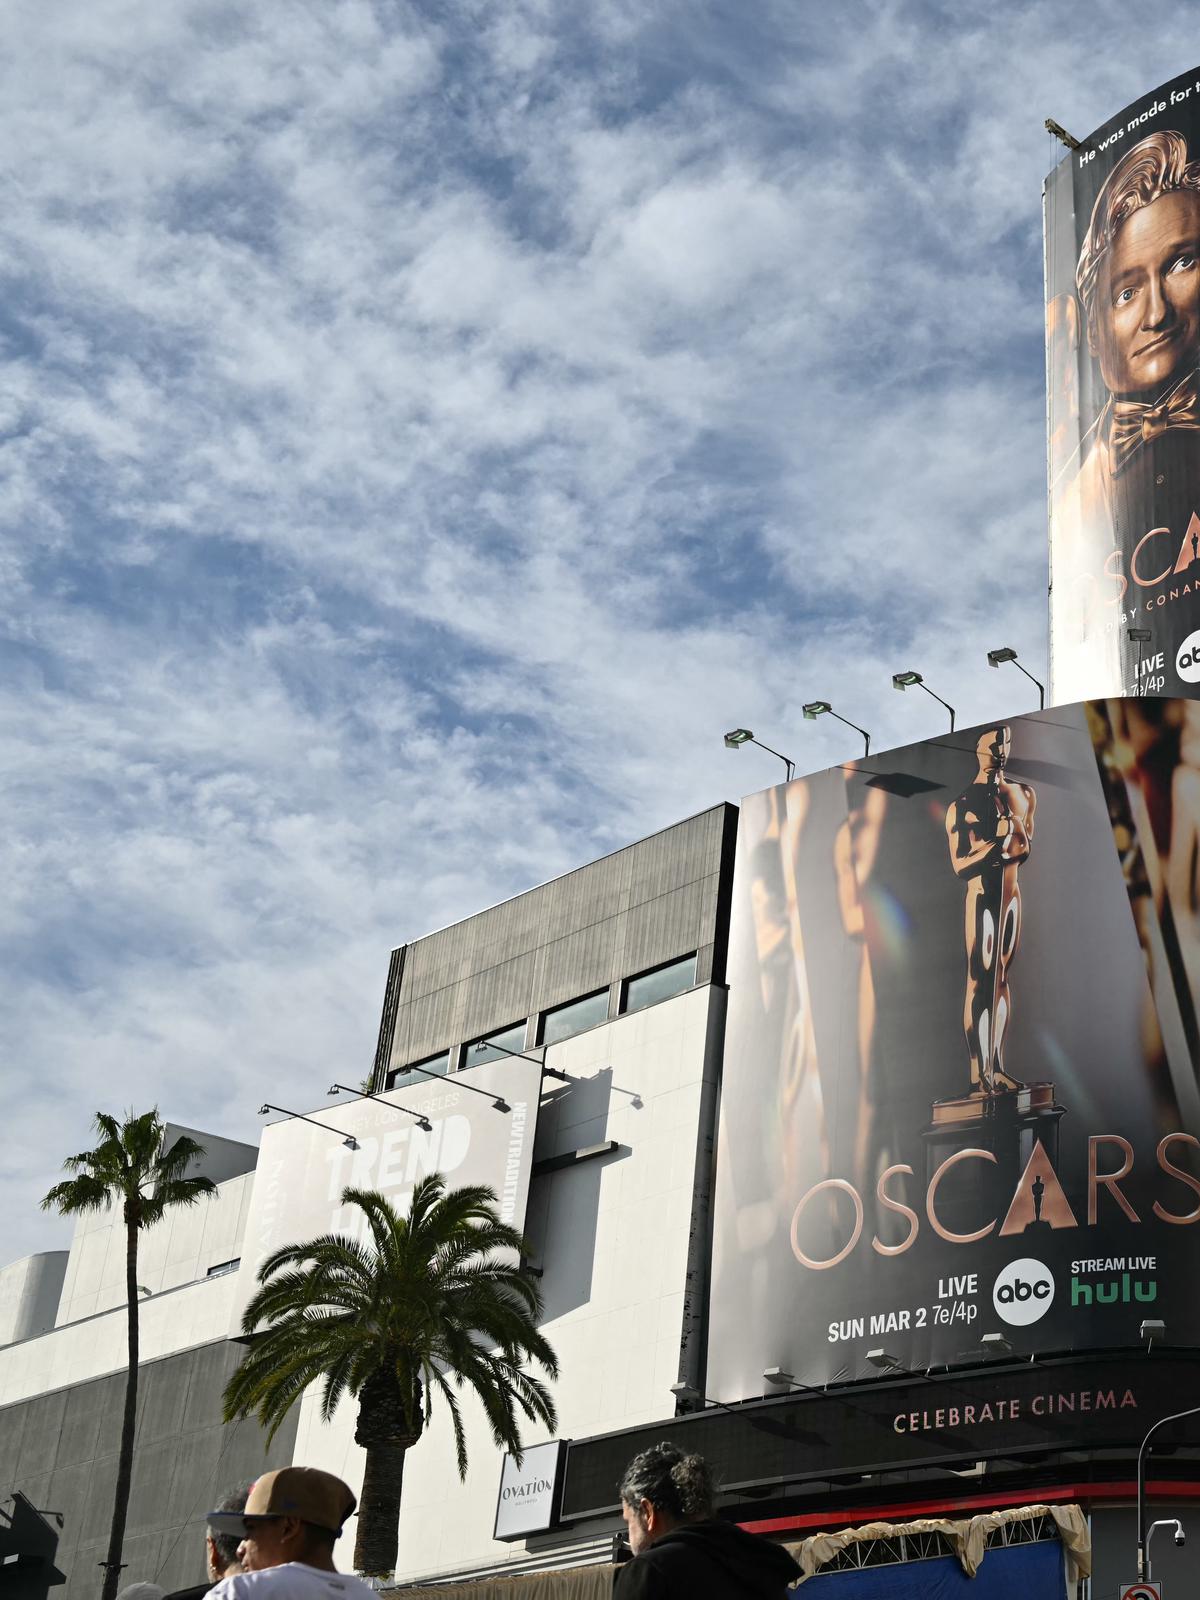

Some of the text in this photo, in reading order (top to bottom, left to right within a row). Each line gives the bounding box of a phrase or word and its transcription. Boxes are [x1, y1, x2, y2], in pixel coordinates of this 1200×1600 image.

[1079, 150, 1096, 168] He
[1098, 129, 1125, 152] was
[1127, 101, 1167, 132] made
[1169, 86, 1193, 106] for
[1121, 608, 1137, 624] BY
[1134, 652, 1165, 680] LIVE
[325, 1115, 471, 1201] TREND
[1071, 1257, 1157, 1274] STREAM LIVE
[938, 1273, 978, 1299] LIVE
[998, 1273, 1051, 1304] abc
[1071, 1273, 1157, 1306] hulu
[828, 1300, 978, 1343] SUN MAR 2 7e/4p
[893, 1389, 1138, 1434] CELEBRATE CINEMA
